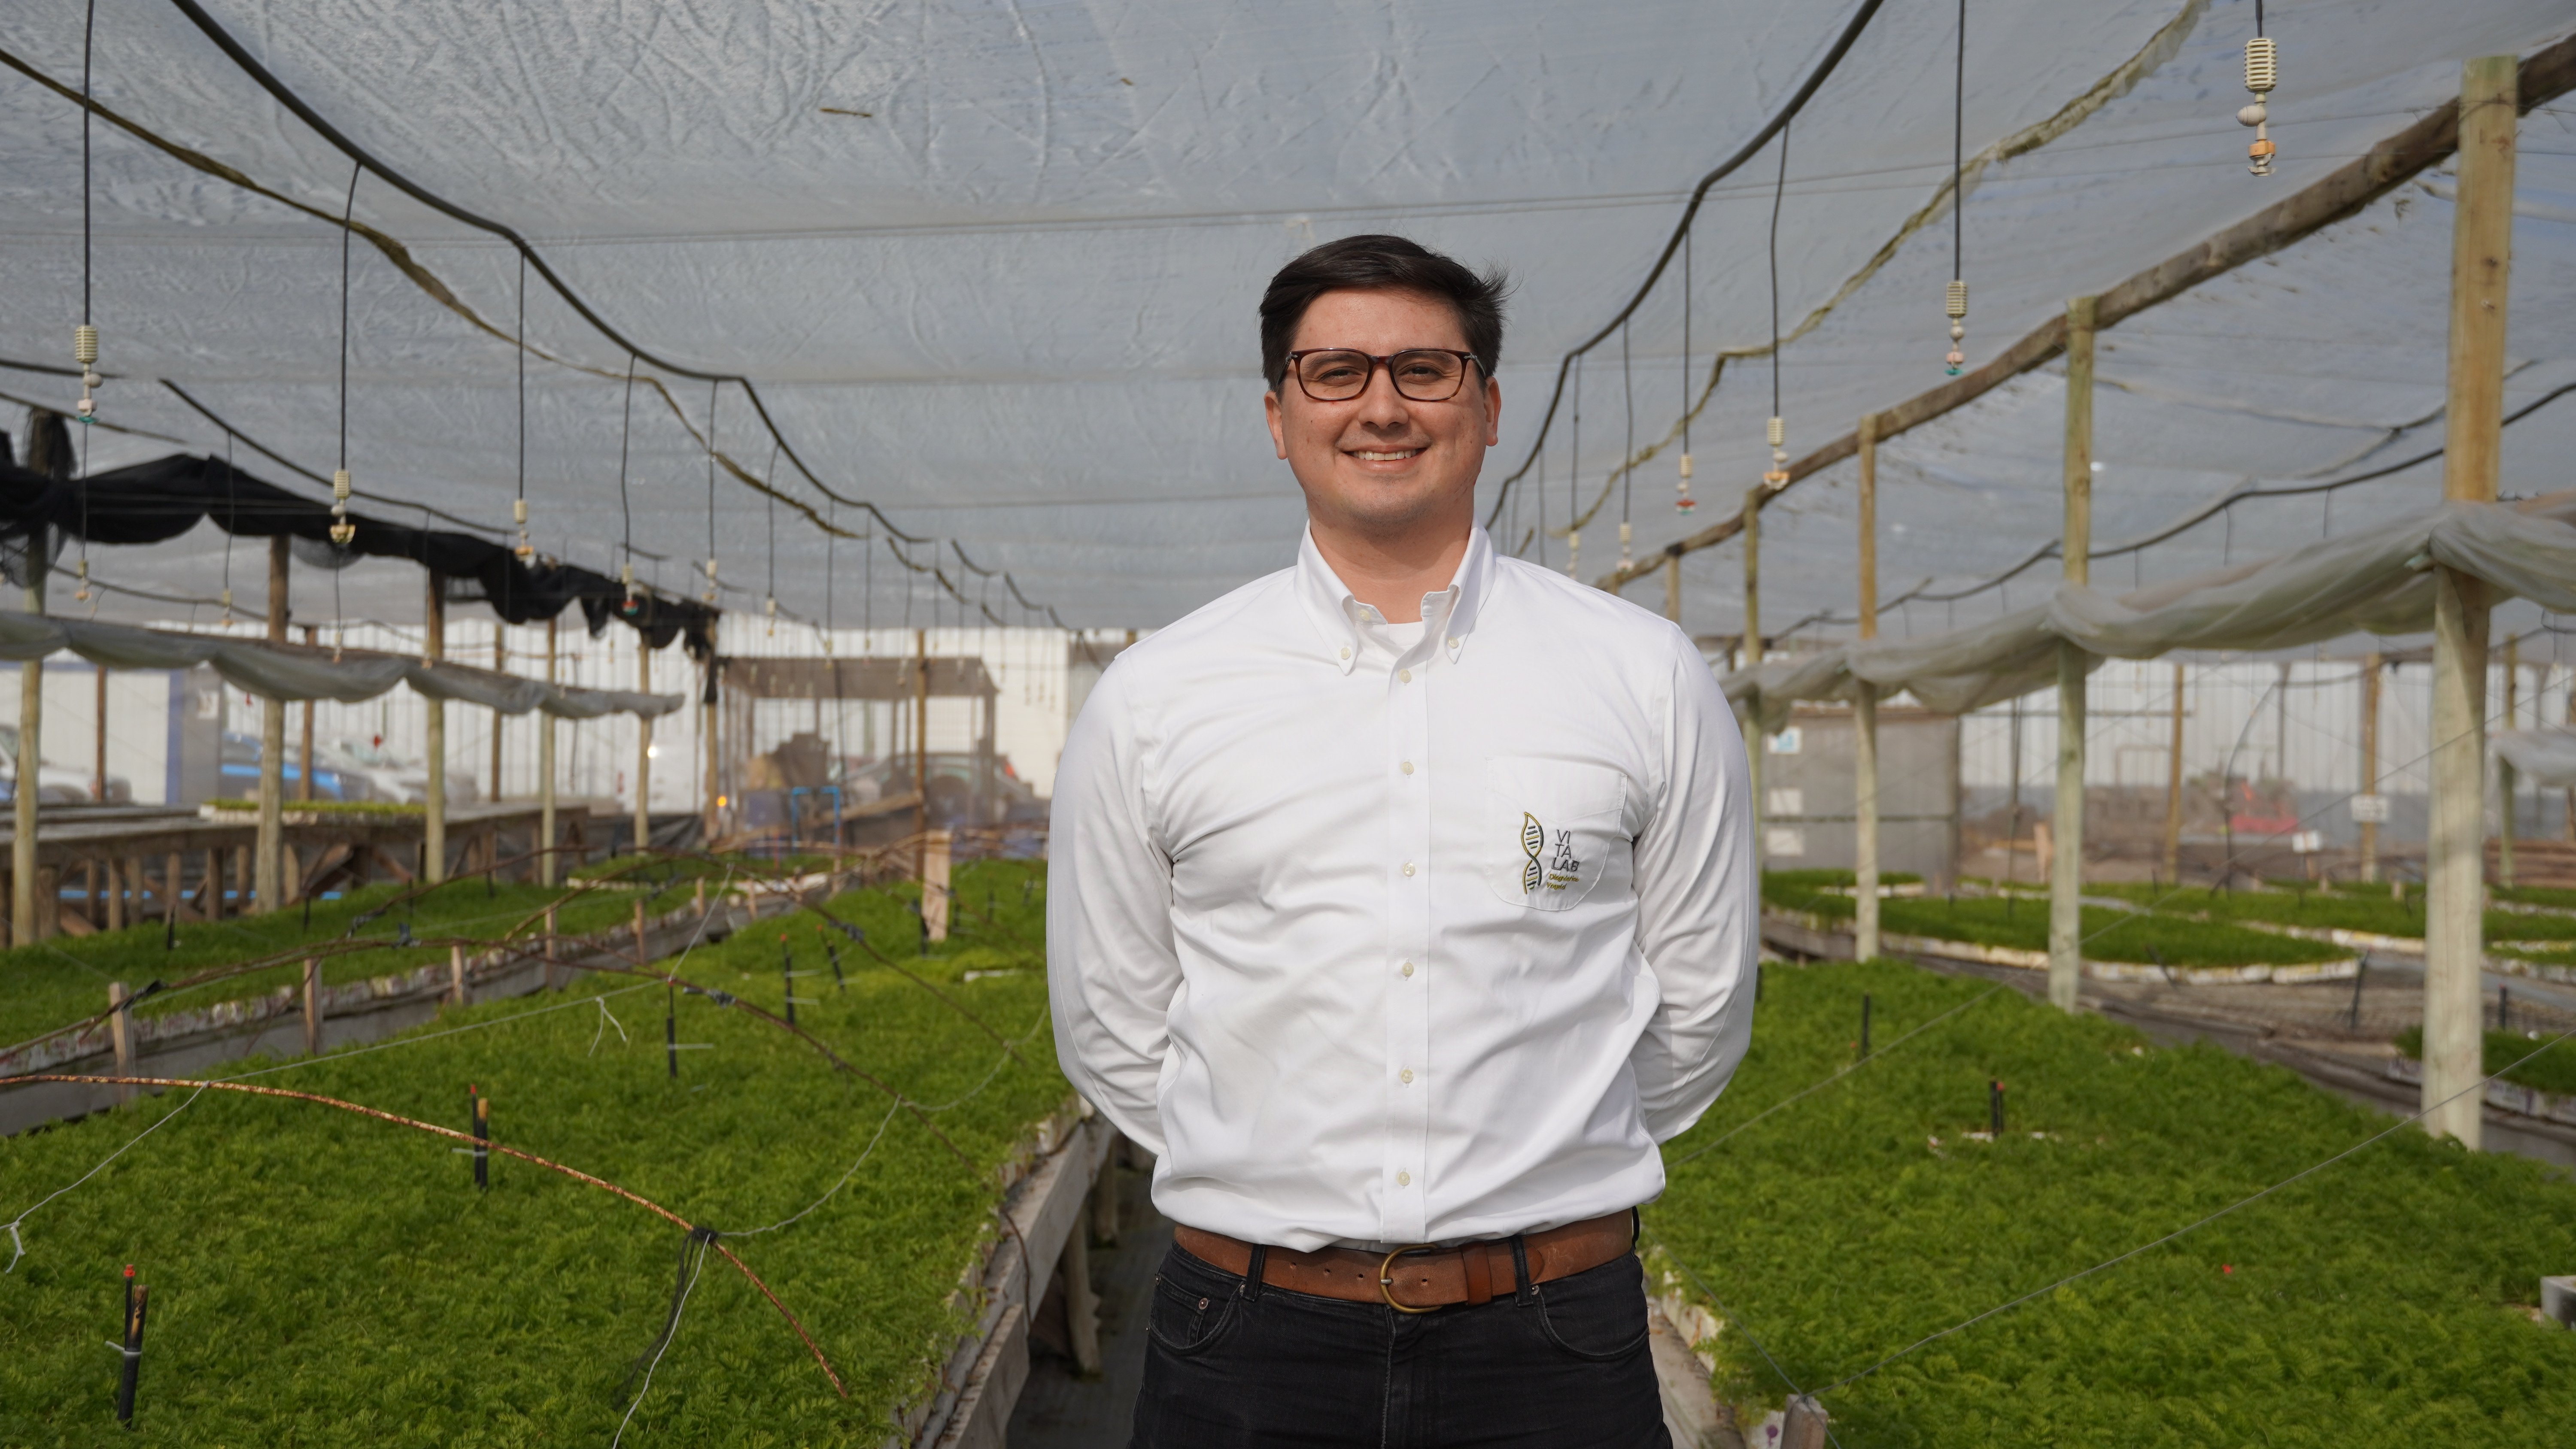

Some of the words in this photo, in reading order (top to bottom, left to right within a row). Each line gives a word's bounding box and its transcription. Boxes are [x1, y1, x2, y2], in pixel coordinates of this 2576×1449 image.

[1557, 829, 1570, 844] VI
[1555, 843, 1571, 858] TA
[1551, 857, 1580, 872] LAB
